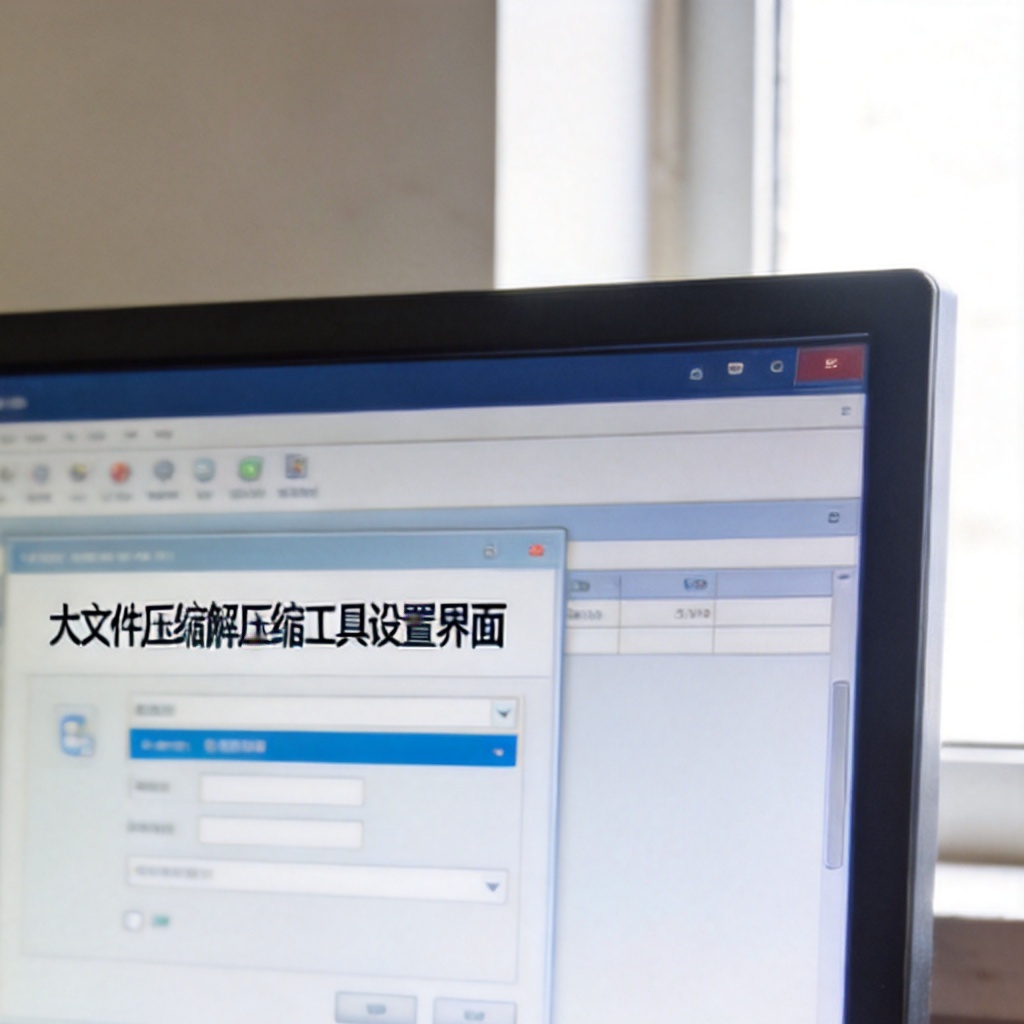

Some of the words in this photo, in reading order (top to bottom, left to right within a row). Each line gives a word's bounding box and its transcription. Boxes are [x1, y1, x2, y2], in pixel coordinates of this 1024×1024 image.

[49, 601, 507, 649] 大文件压缩解压缩工具设置界面
